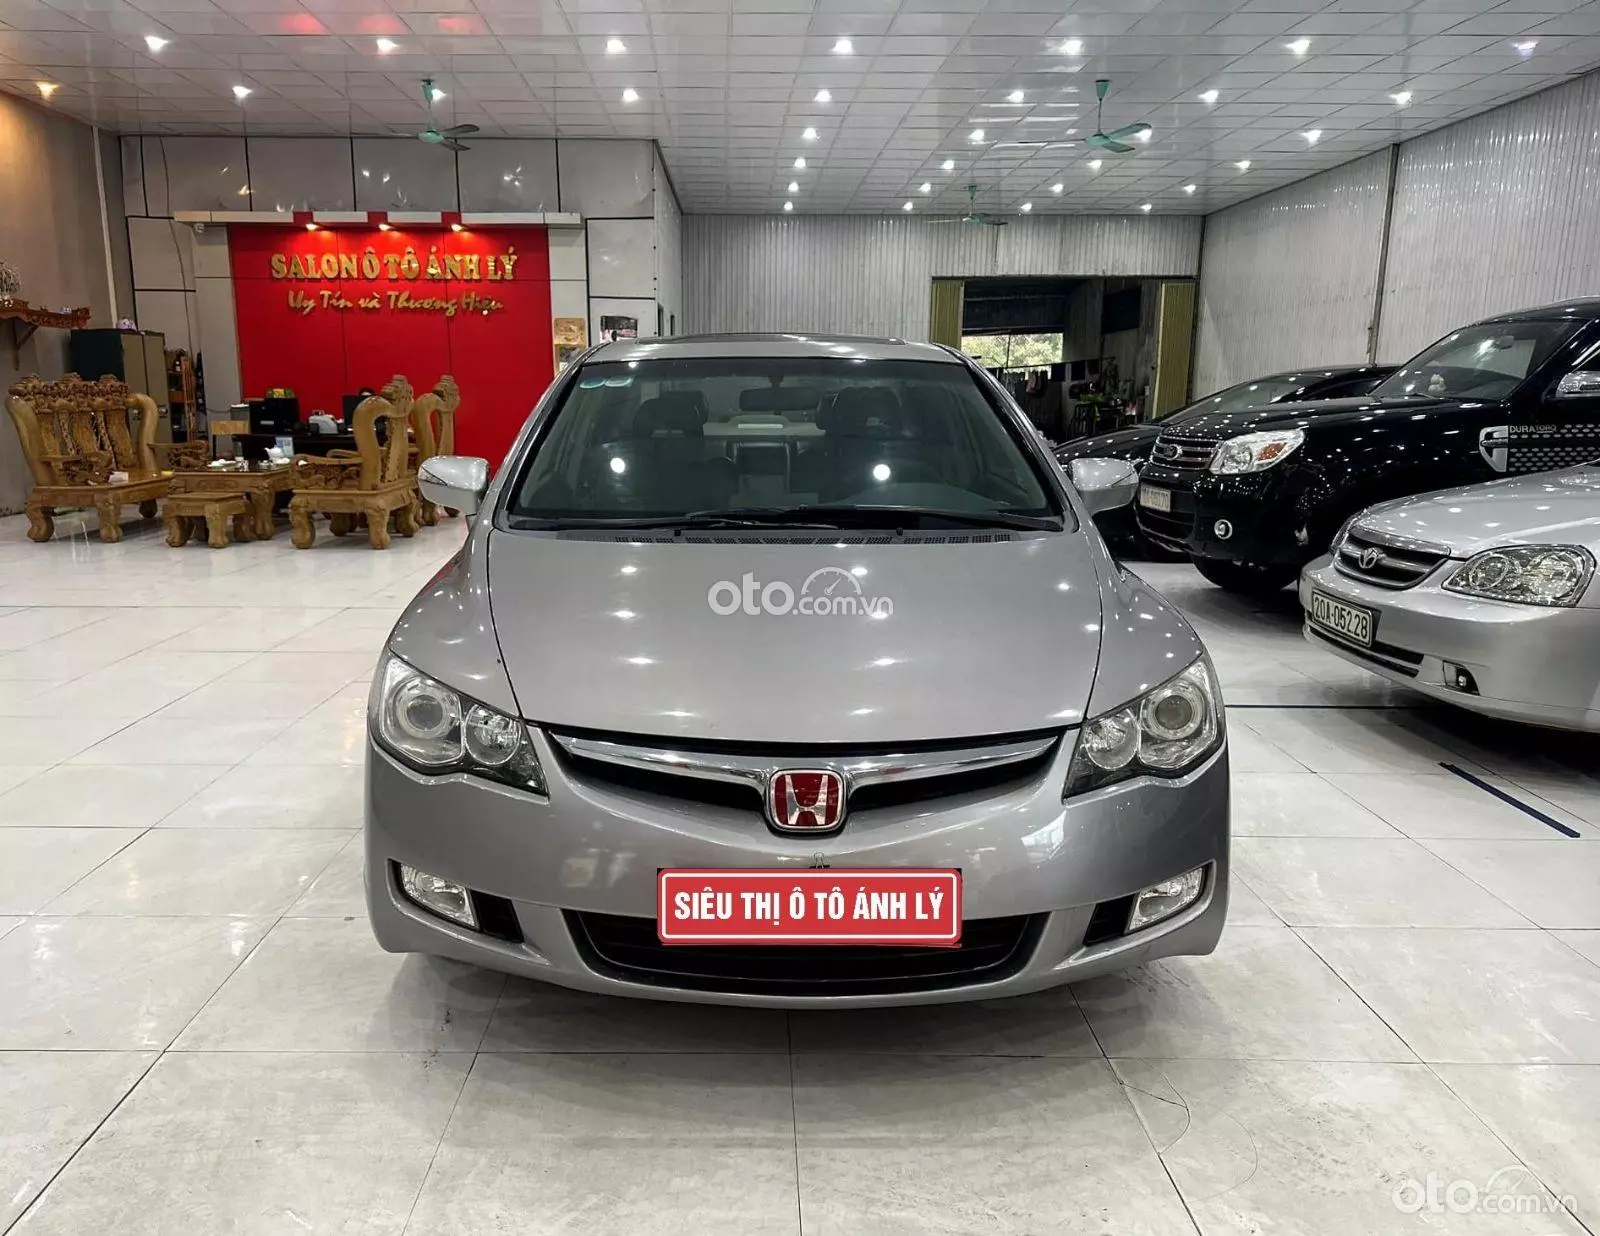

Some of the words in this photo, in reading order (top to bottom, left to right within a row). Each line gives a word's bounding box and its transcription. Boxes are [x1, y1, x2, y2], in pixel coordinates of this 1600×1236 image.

[271, 253, 358, 279] SALON
[362, 246, 380, 279] Ô
[384, 246, 419, 279] TÔ
[425, 245, 480, 280] ÁNH
[487, 246, 517, 280] LÝ
[288, 290, 316, 315] Uy
[320, 290, 353, 309] Tín
[359, 291, 380, 309] và
[1509, 424, 1557, 434] DURATORQ
[674, 886, 732, 920] SIÊU
[740, 892, 780, 926] THỊ
[789, 886, 806, 920] Ô
[813, 886, 845, 920] TÔ
[852, 886, 906, 920] ÁNH
[915, 886, 944, 920] LÝ
